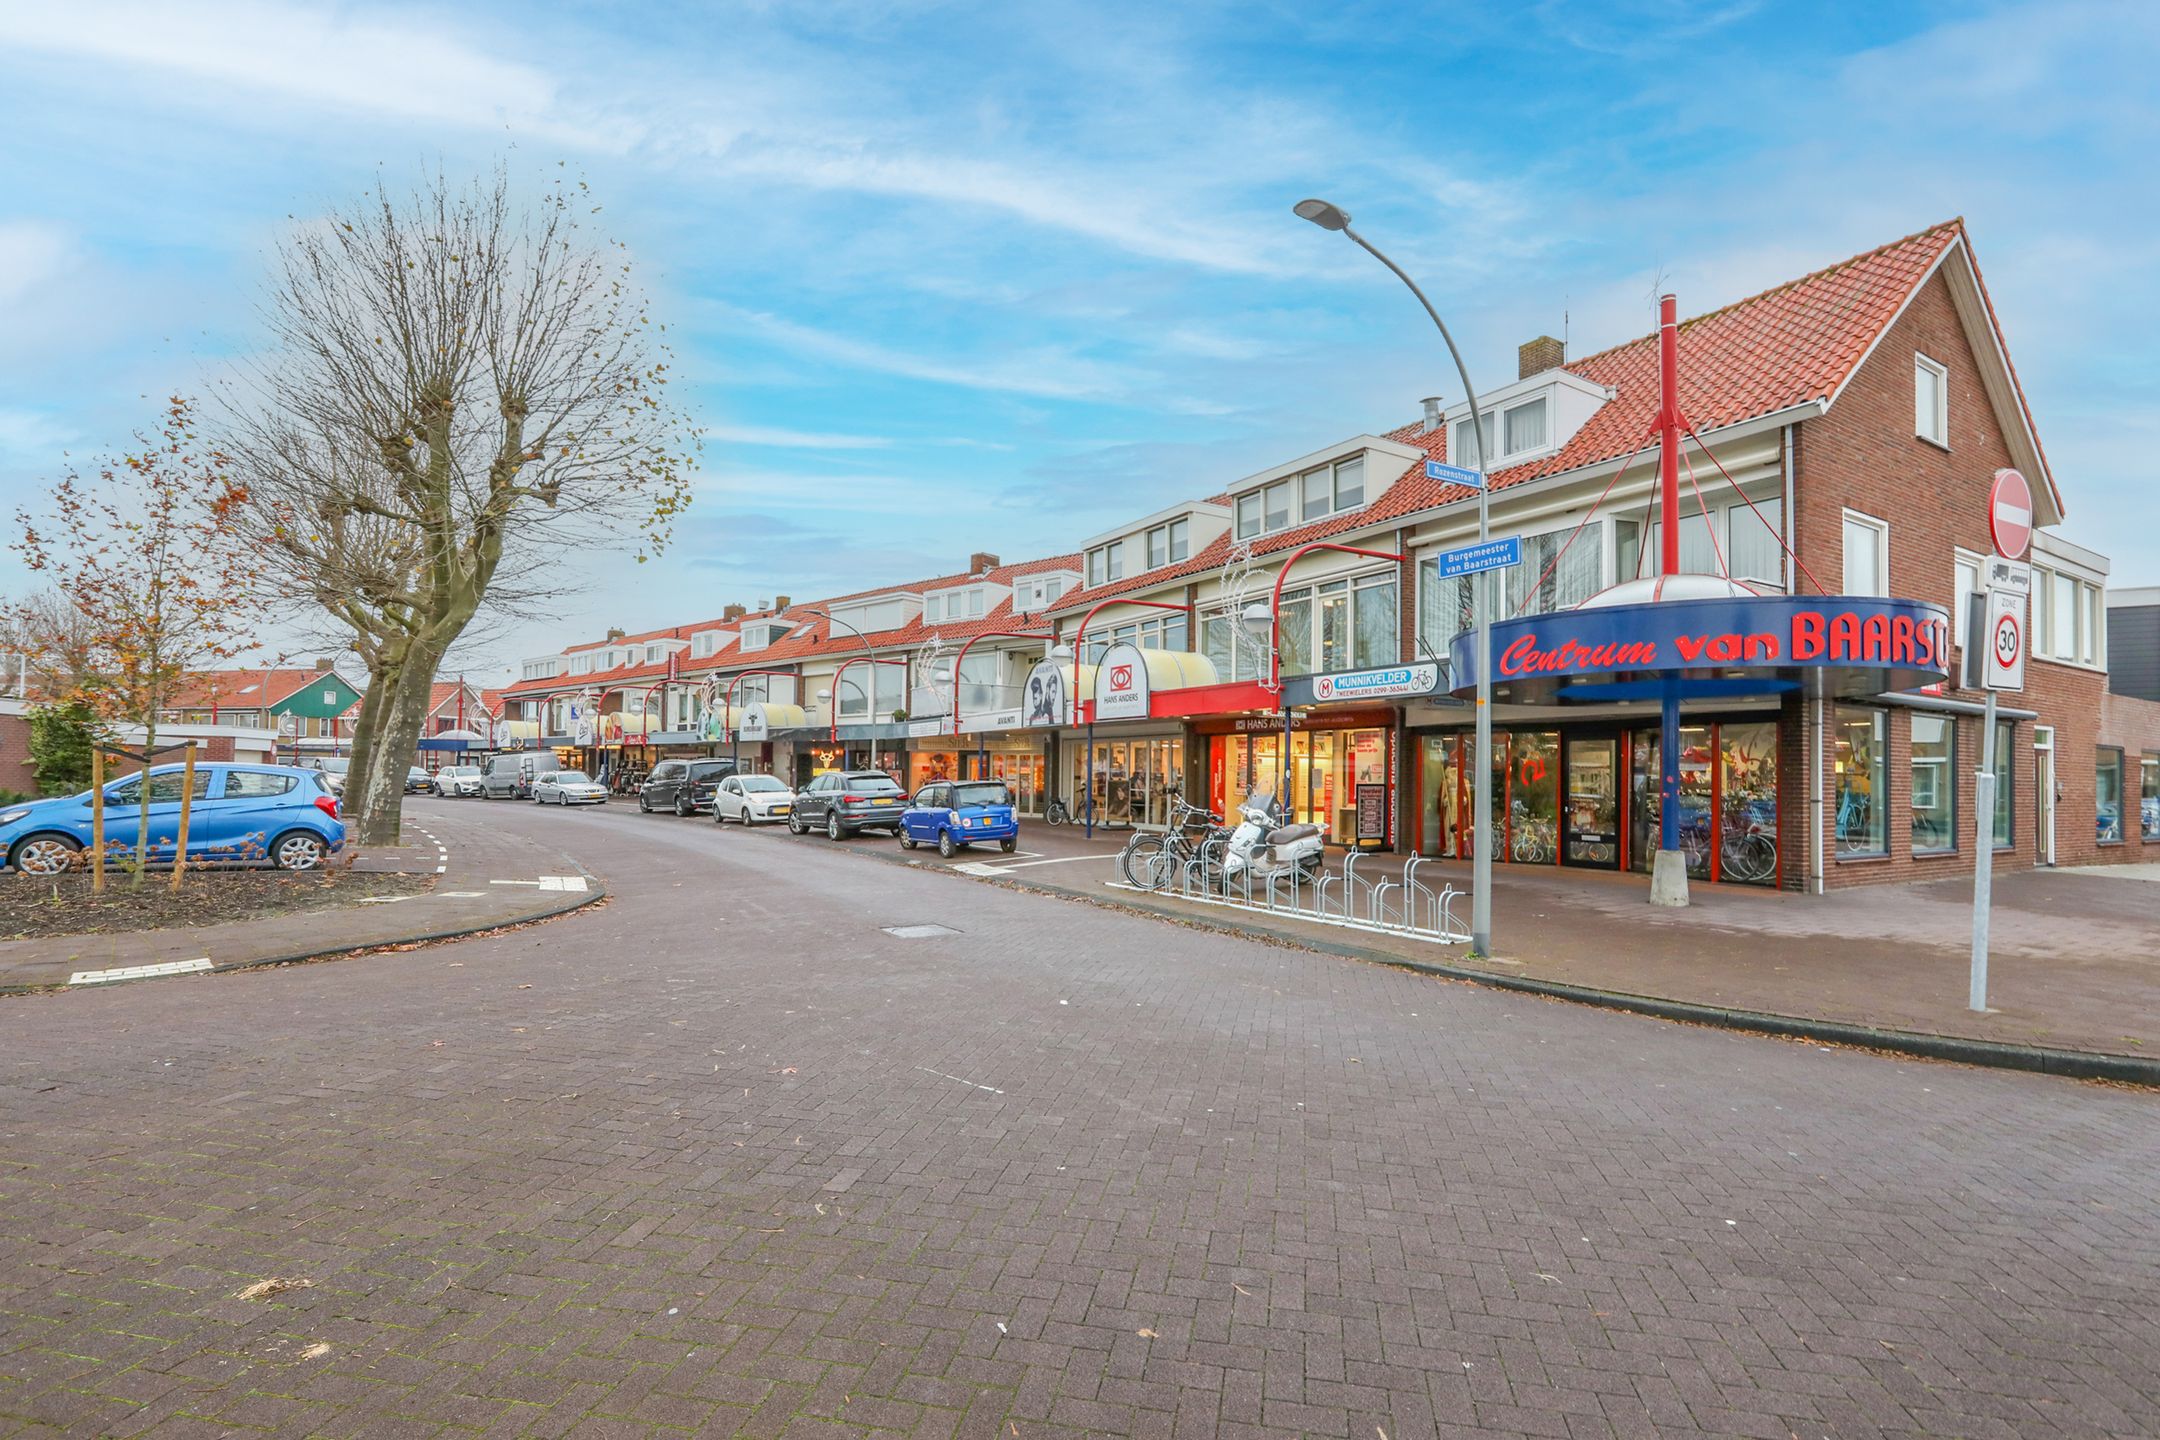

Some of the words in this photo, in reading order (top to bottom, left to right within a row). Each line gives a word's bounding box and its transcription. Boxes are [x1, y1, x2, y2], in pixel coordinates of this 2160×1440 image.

[1448, 543, 1509, 563] Burgemeester
[1446, 564, 1461, 574] van
[1464, 553, 1511, 570] Baarstraat
[2001, 598, 2016, 609] ZONE
[1999, 630, 2016, 652] 30
[1500, 634, 1657, 676] Centrum
[1674, 633, 1780, 662] van
[1338, 670, 1407, 688] MUNNIKVELDER
[1104, 696, 1118, 704] HANS
[1119, 693, 1138, 703] ANDERS
[1247, 718, 1268, 730] HANS
